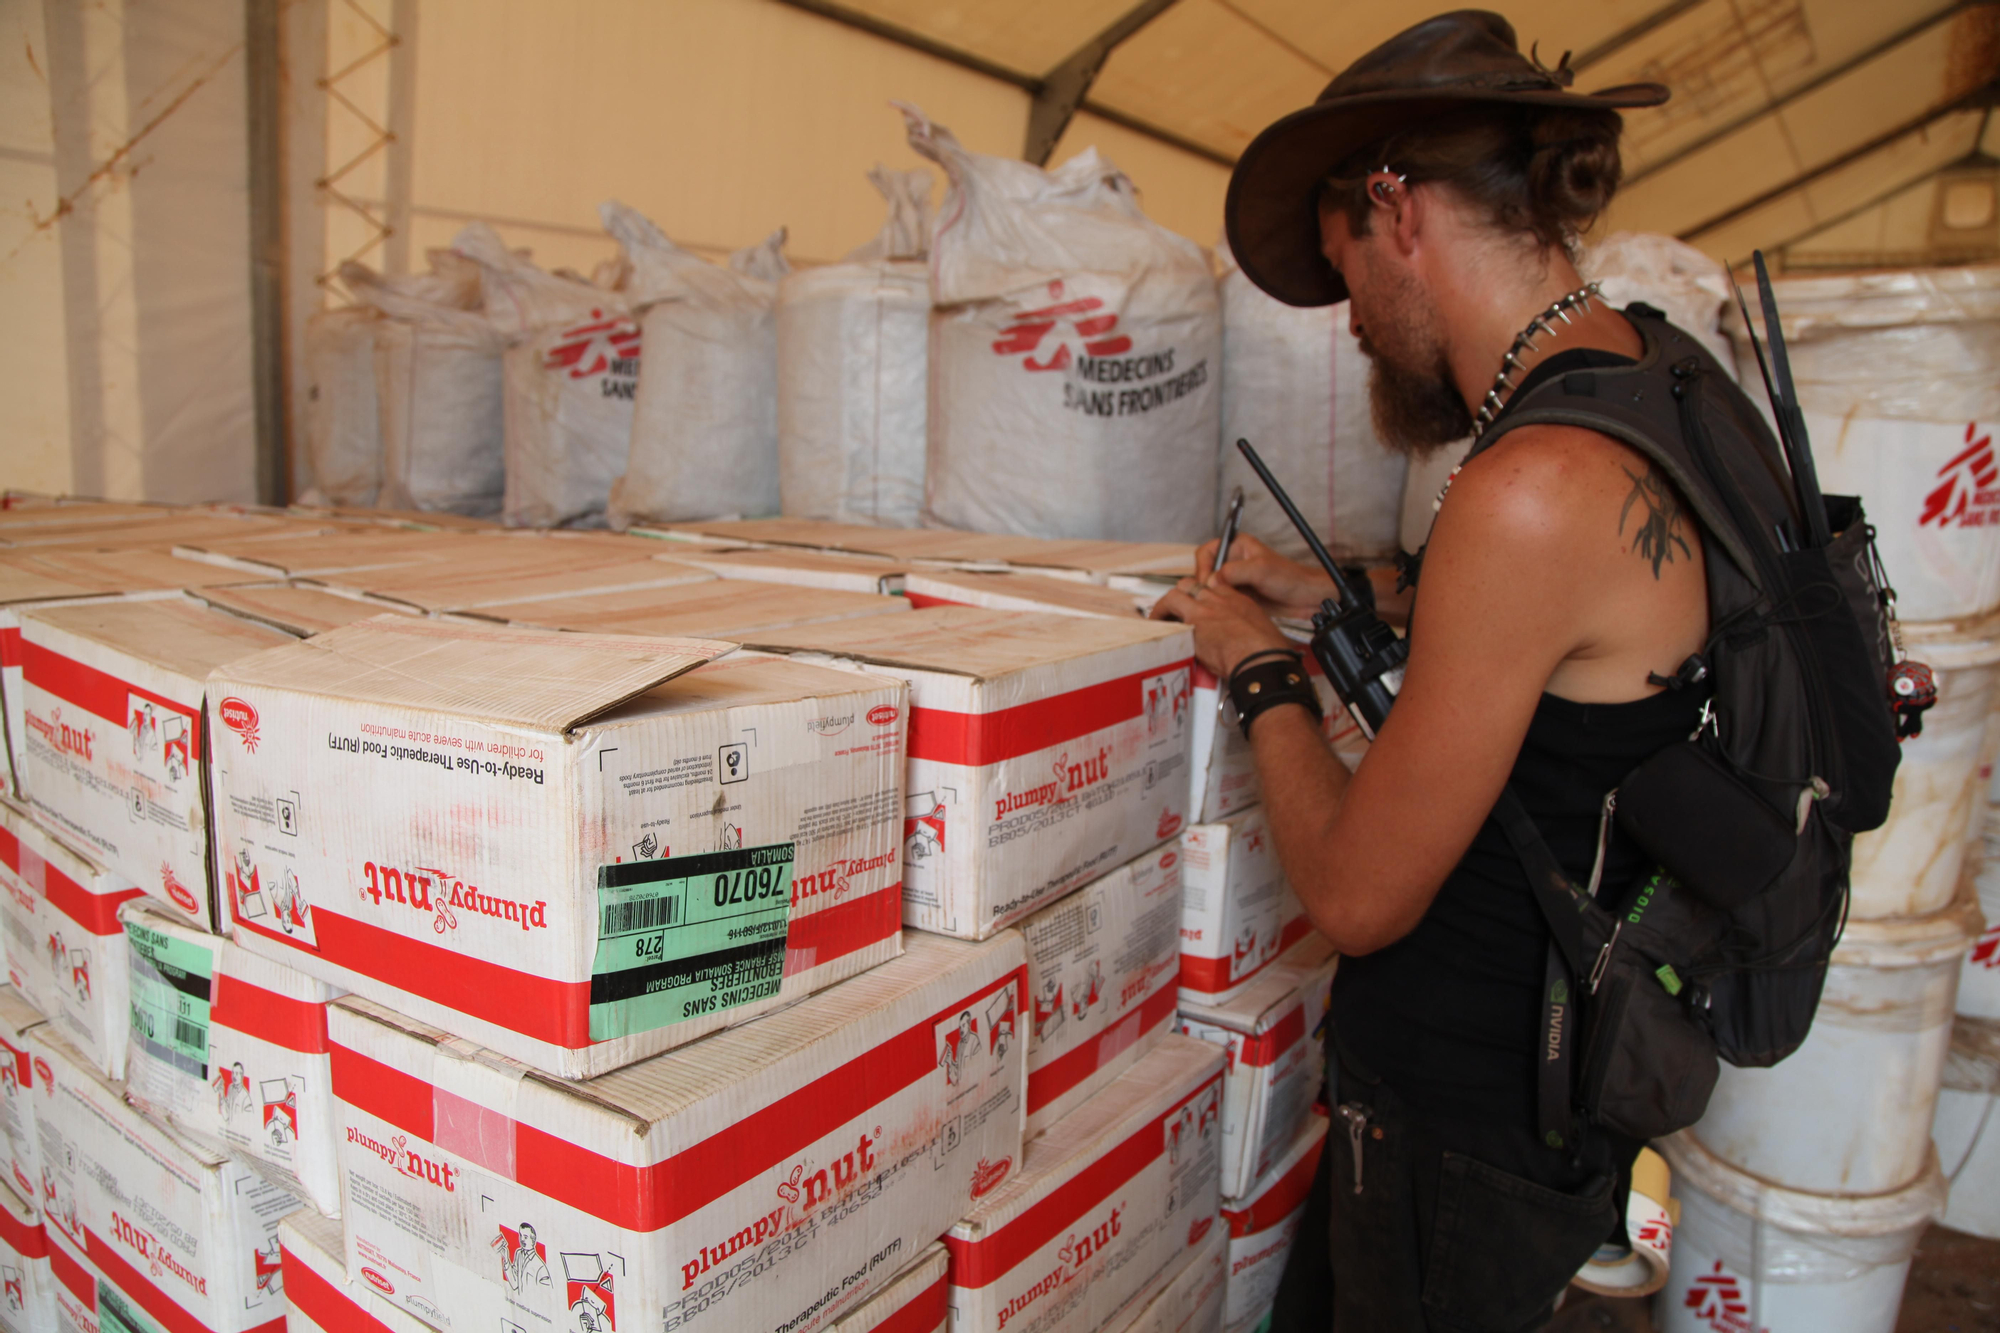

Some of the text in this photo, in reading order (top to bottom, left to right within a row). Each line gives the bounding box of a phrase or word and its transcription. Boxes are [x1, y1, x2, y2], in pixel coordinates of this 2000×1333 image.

[1076, 347, 1175, 382] MEDECINS
[328, 732, 544, 784] Ready-to-Use Therapeutic Food (RUTF)
[360, 722, 544, 763] for children with severe acute malnutrition
[995, 780, 1057, 821] plumpy
[1067, 747, 1108, 792] nut
[751, 846, 794, 862] SOMALIA
[846, 848, 895, 877] plumpy
[449, 880, 547, 931] plumpy
[714, 866, 784, 907] 76070
[151, 932, 169, 950] SANS
[636, 935, 662, 957] 278
[646, 951, 785, 993] MSF FRANCE SOMALIA PROGRAM
[710, 963, 783, 993] FRONTIERES
[683, 979, 782, 1018] MEDECINS SANS
[347, 1126, 396, 1164] plumpy
[681, 1206, 787, 1290] plumpy
[775, 1238, 902, 1333] Therapeutic Food (RUTF)
[998, 1265, 1064, 1331] plumpy
[1074, 1207, 1121, 1269] nut
[822, 1278, 869, 1319] malnutrition
